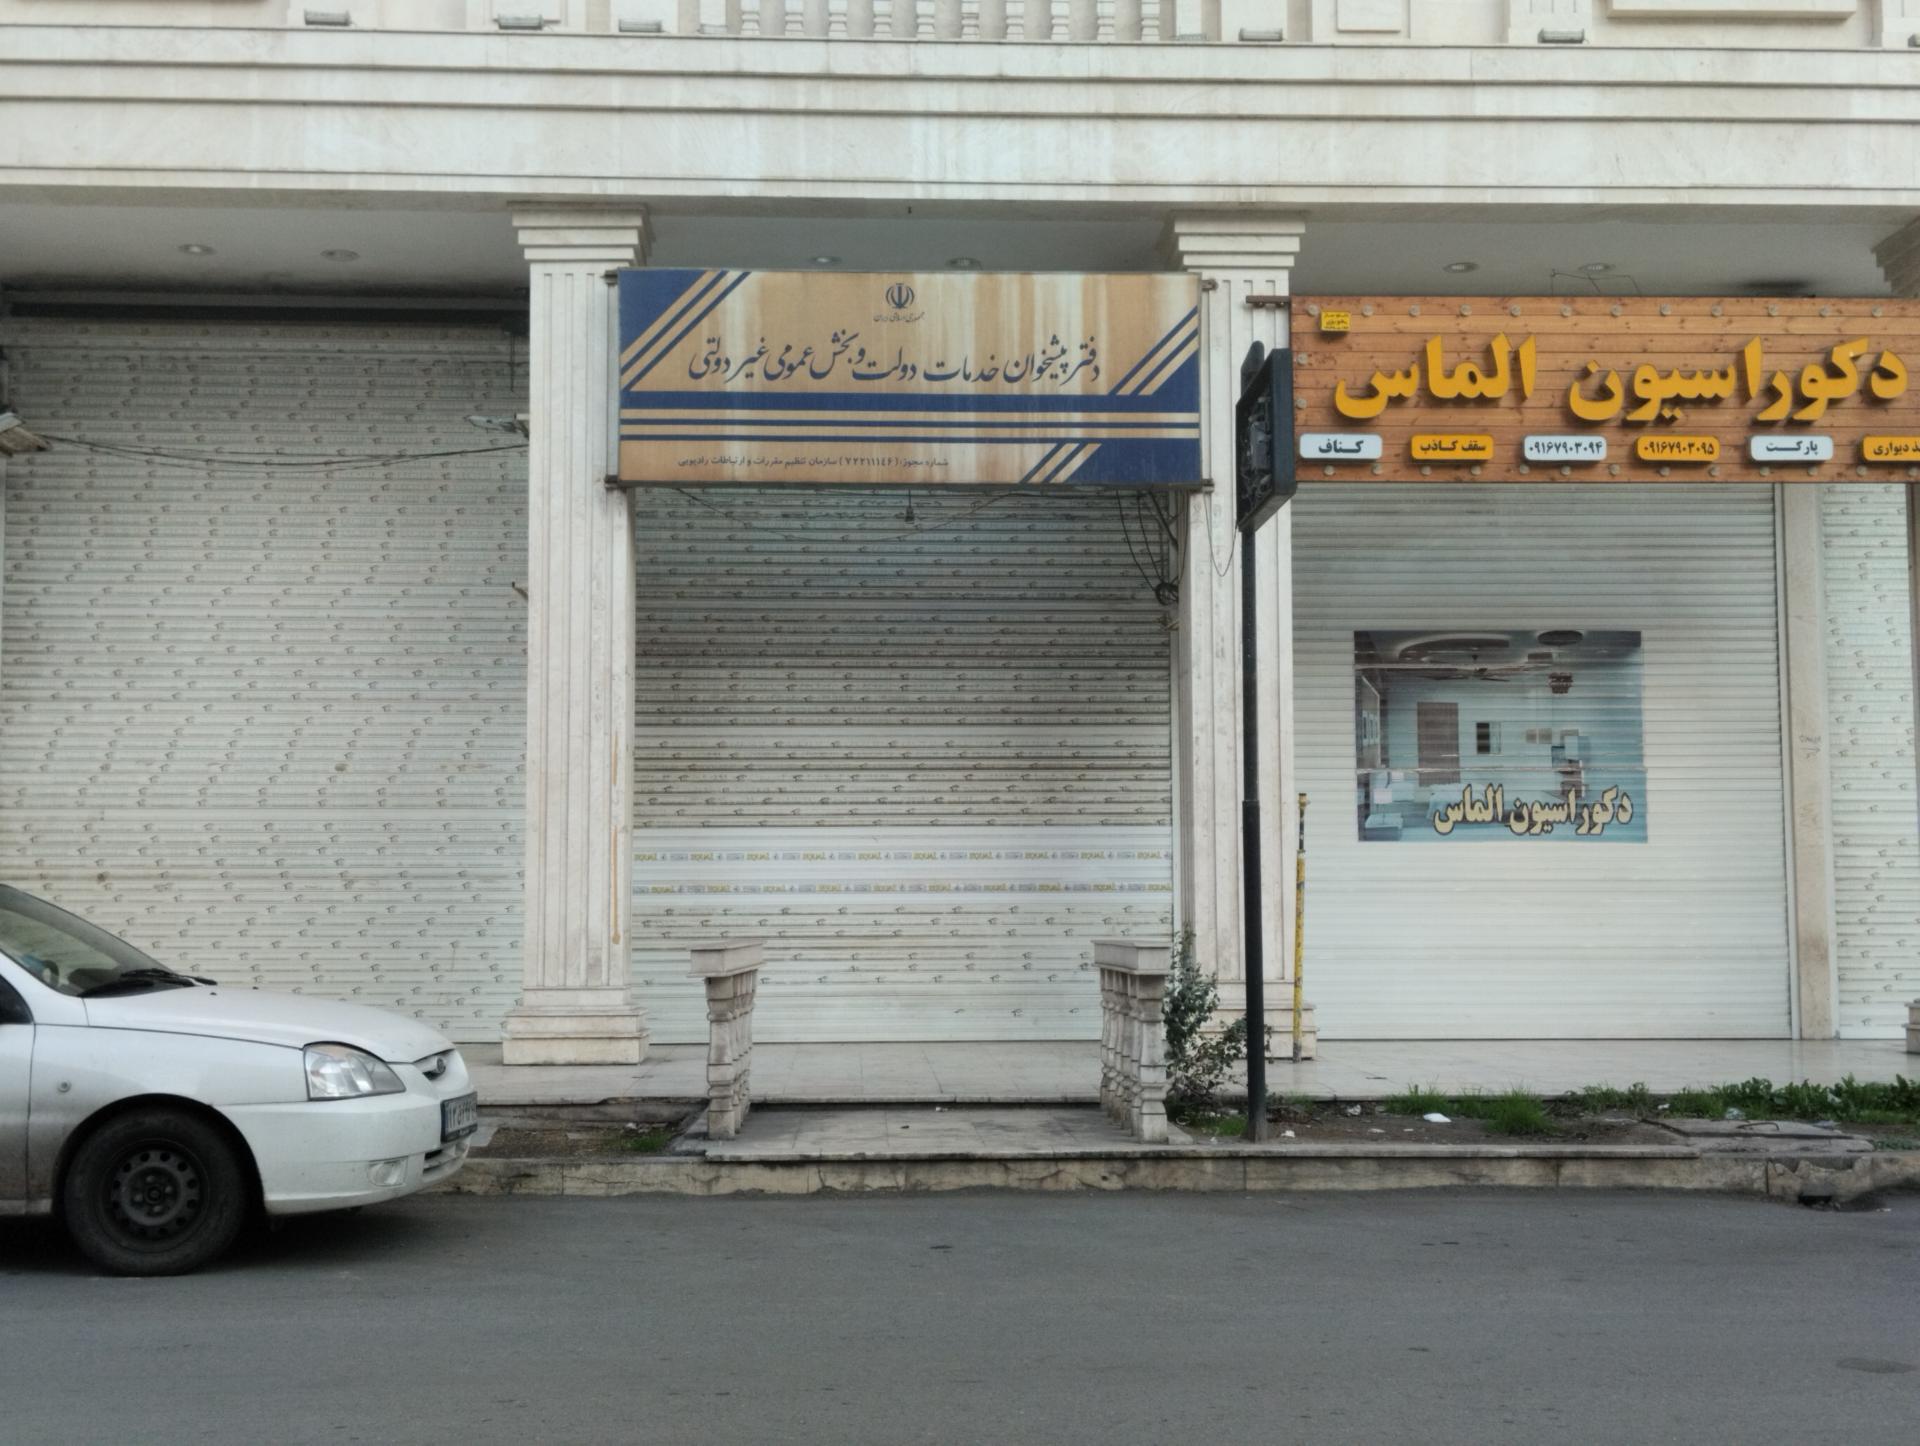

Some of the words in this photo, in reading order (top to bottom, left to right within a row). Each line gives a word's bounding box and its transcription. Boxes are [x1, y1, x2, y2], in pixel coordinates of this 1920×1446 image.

[688, 336, 731, 380] دولتی
[724, 336, 769, 384] غیر
[763, 344, 814, 381] عمومی
[809, 329, 860, 380] بخش
[852, 346, 917, 381] دولت
[854, 347, 866, 364] و
[922, 353, 1000, 382] خدمات
[1003, 333, 1068, 384] پیشخوان
[1060, 335, 1100, 386] دفتر
[1335, 331, 1537, 419] الماس
[1569, 336, 1908, 421] دکوراسیون
[1318, 437, 1364, 454] کناف
[1420, 439, 1458, 454] کاذب
[1461, 438, 1486, 452] سقف
[1766, 440, 1818, 456] پارکت
[1873, 441, 1909, 456] دیواری
[1433, 783, 1505, 836] الماس
[1508, 784, 1634, 836] دکوراسیون
